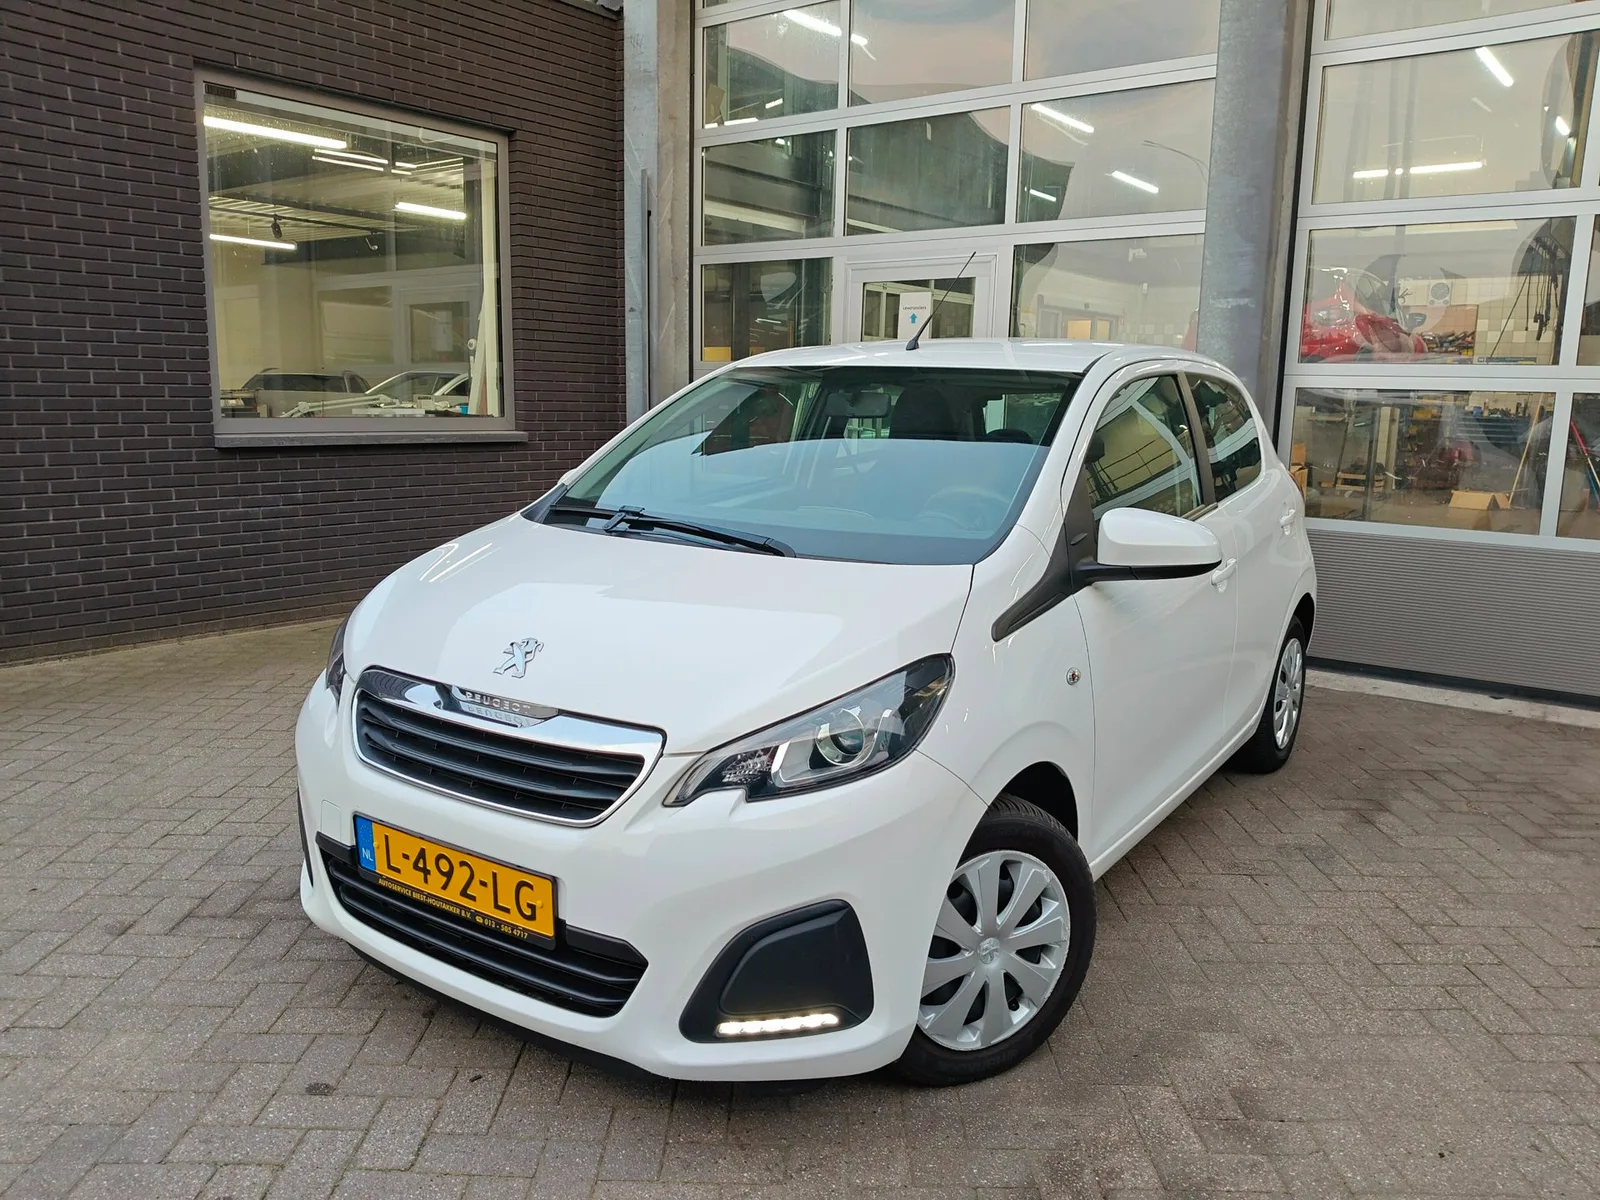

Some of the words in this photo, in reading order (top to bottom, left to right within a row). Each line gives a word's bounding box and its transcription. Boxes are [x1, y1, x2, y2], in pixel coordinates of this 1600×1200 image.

[465, 691, 531, 714] PEUGEOT
[362, 847, 374, 862] NL
[384, 833, 537, 922] L-492-LG
[378, 878, 412, 897] AUTOSERVICE
[412, 892, 461, 916] BIEST-HOUTAKKER
[461, 910, 472, 919] B.V.
[484, 918, 496, 928] 013
[501, 924, 512, 934] 505
[512, 928, 528, 939] 4717
